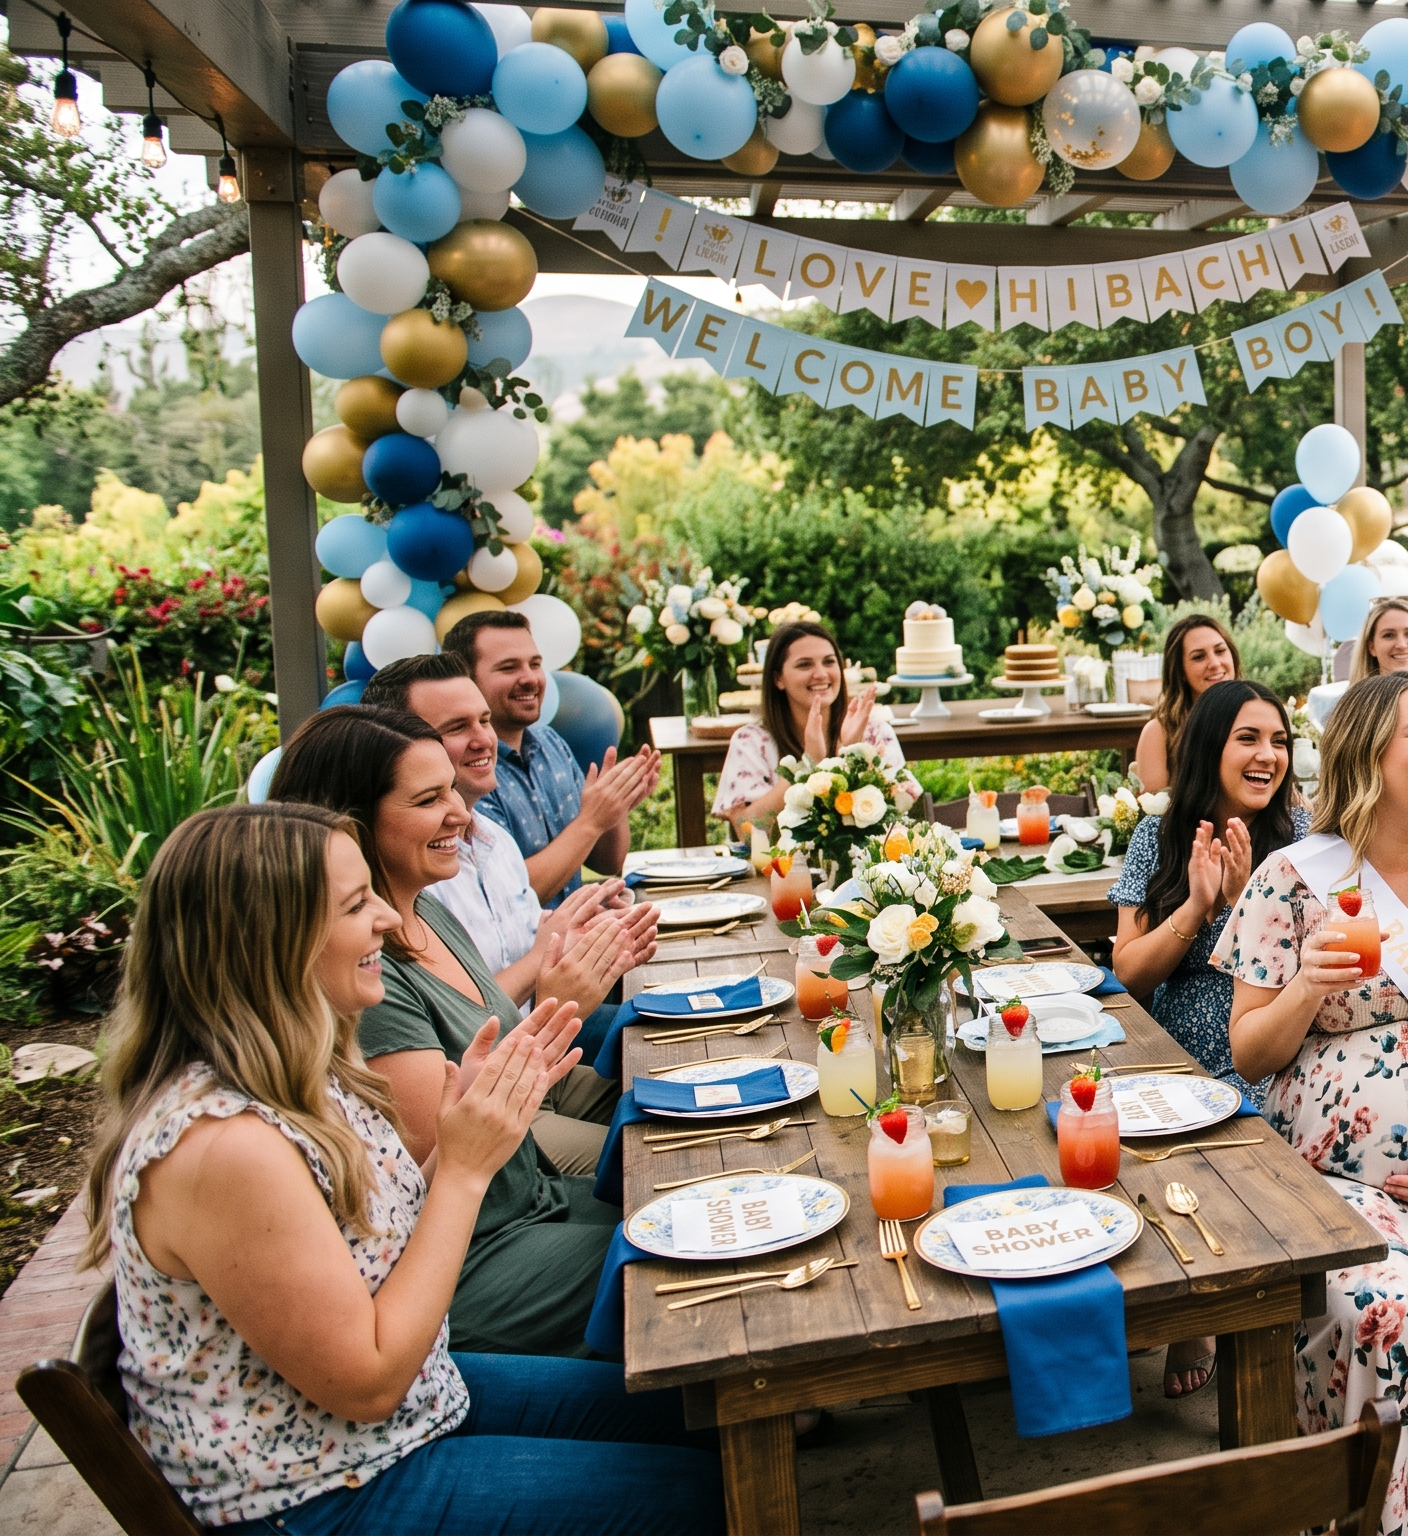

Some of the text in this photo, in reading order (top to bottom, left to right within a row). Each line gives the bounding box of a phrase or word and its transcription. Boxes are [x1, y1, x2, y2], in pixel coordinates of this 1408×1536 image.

[754, 240, 931, 307] LOVE
[1009, 233, 1304, 313] HIBACHI
[643, 287, 1382, 412] WELCOME BABY BOY!
[706, 1199, 737, 1247] SHOWER
[741, 1200, 773, 1232] BABY
[984, 1219, 1059, 1241] BABY
[972, 1228, 1094, 1255] SHOWER
